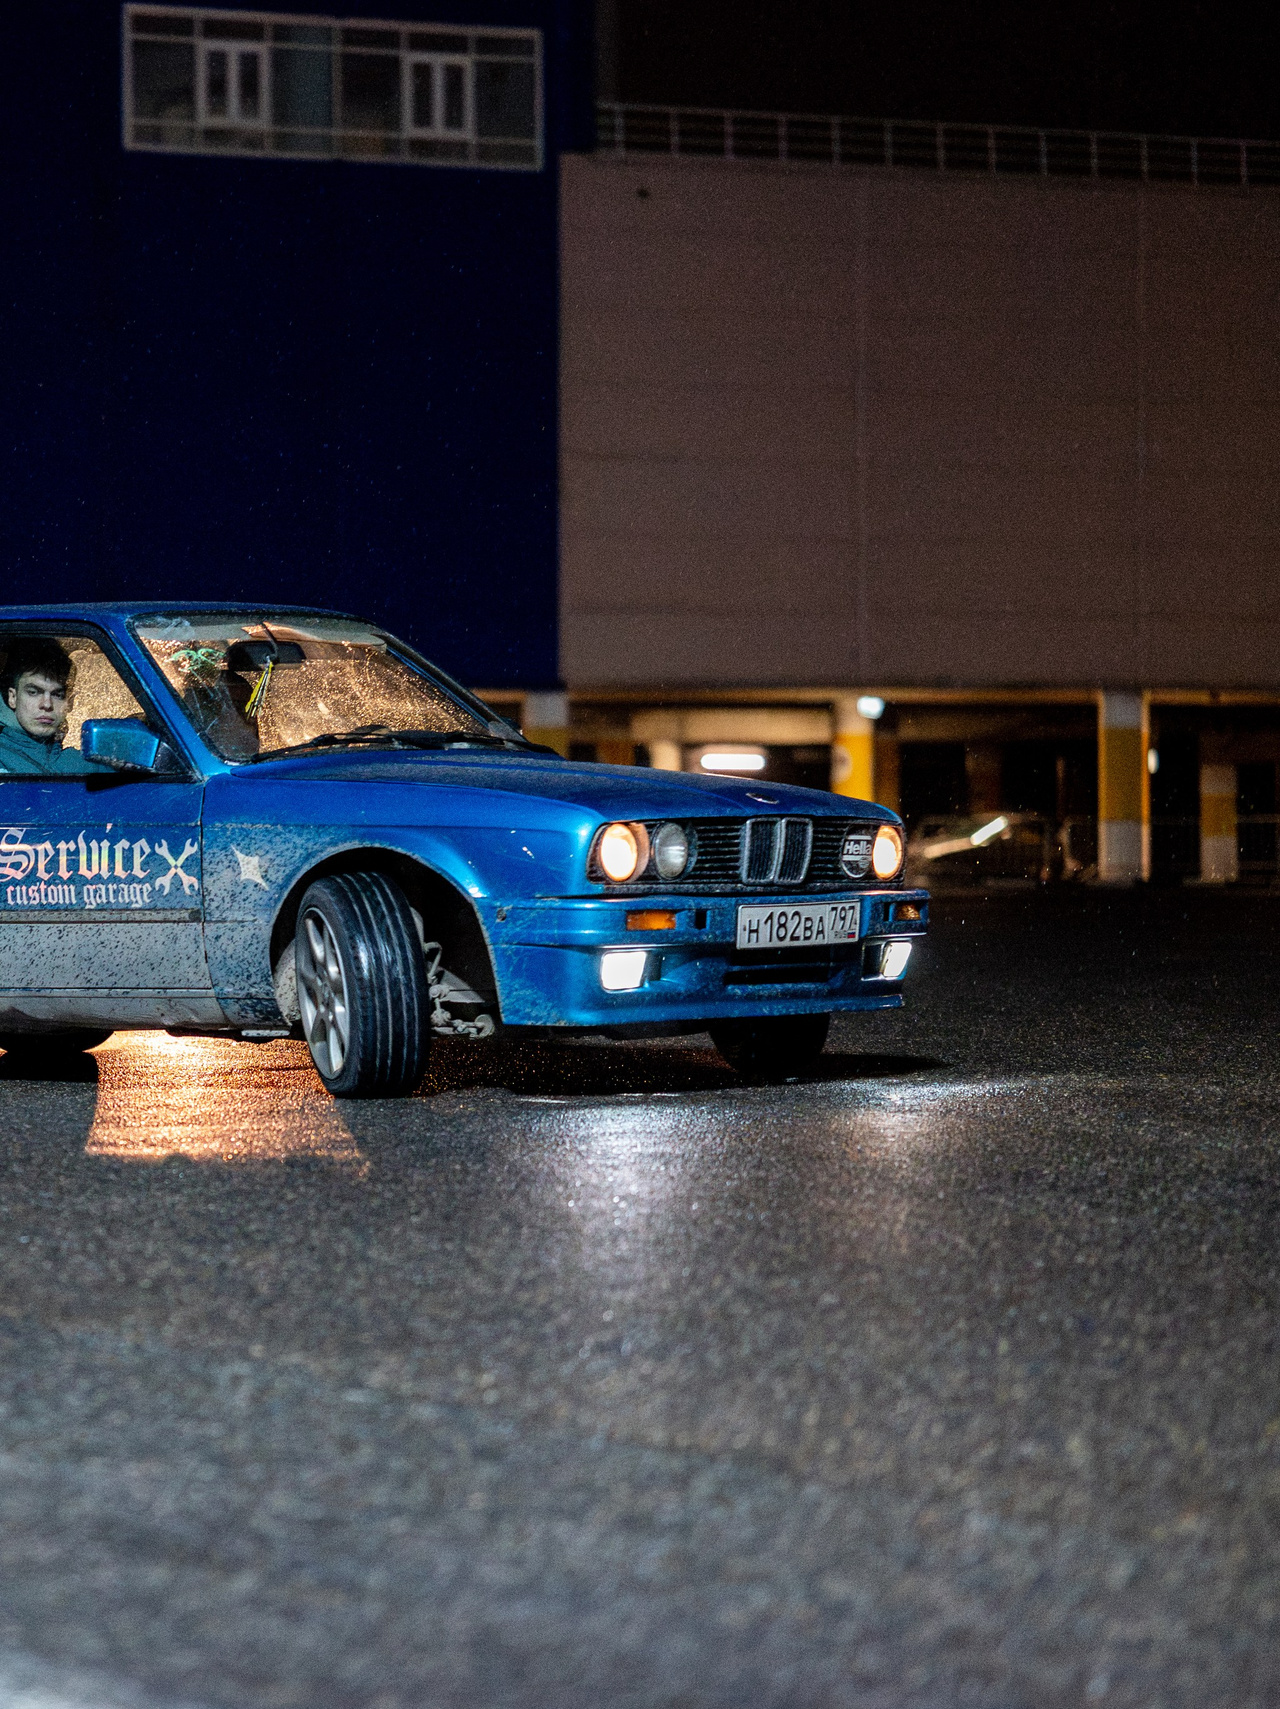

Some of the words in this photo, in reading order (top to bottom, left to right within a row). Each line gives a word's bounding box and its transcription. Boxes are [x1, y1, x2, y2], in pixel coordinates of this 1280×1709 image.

[843, 841, 872, 855] Hella
[6, 881, 76, 905] custom
[83, 882, 152, 908] garage
